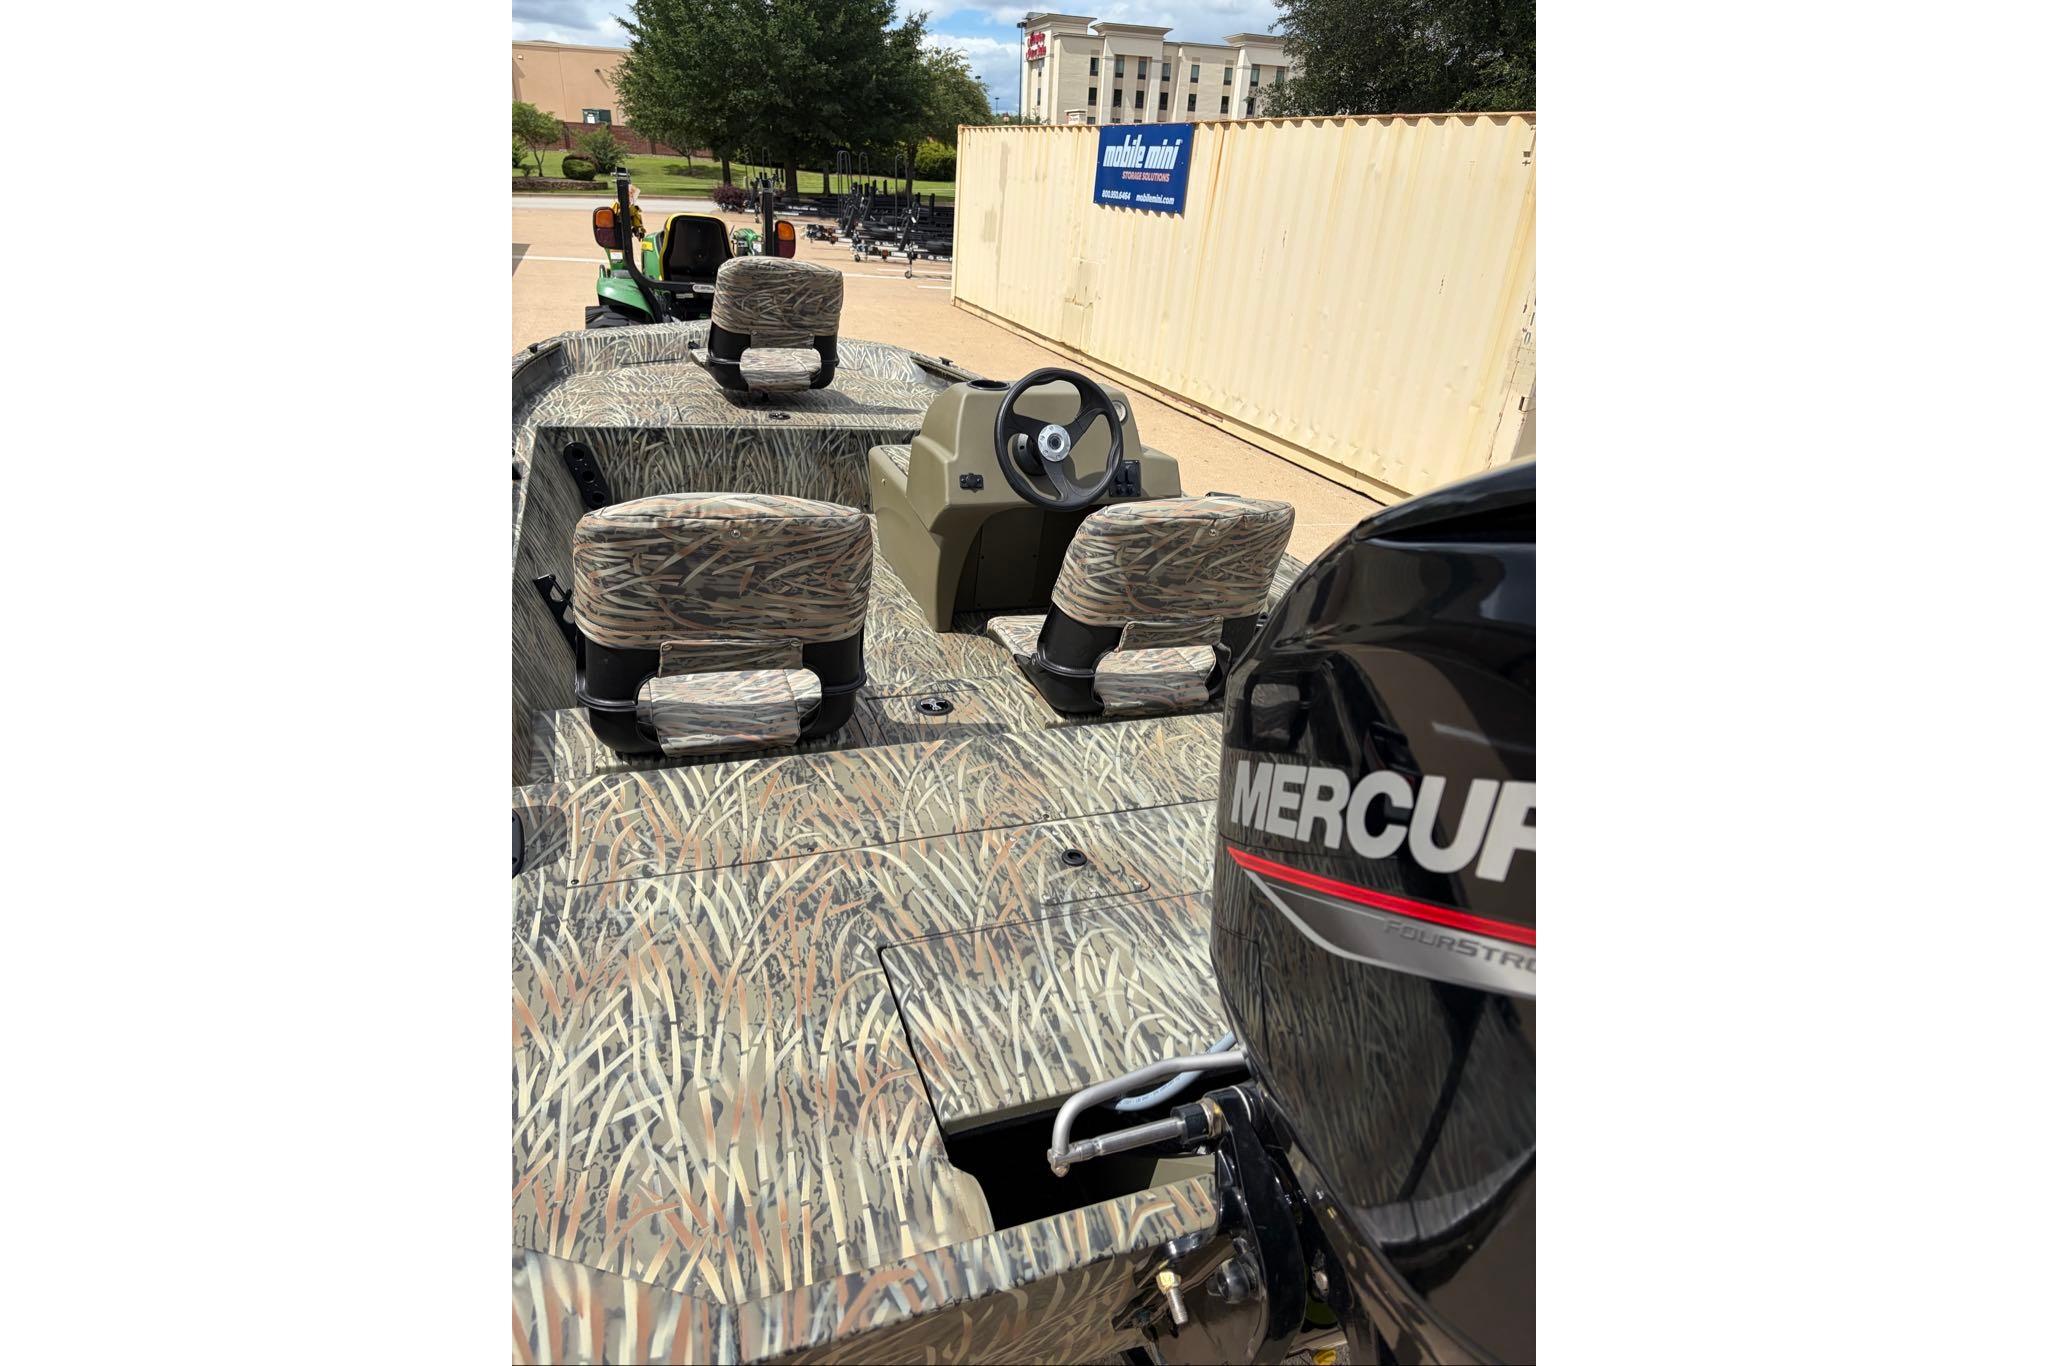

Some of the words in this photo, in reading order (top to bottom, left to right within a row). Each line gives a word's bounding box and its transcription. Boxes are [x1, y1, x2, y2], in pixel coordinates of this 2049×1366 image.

[1103, 134, 1146, 168] mobile
[1144, 139, 1179, 169] mini
[1142, 172, 1170, 182] SOLUTIONS
[1135, 193, 1175, 205] mobilemini.com
